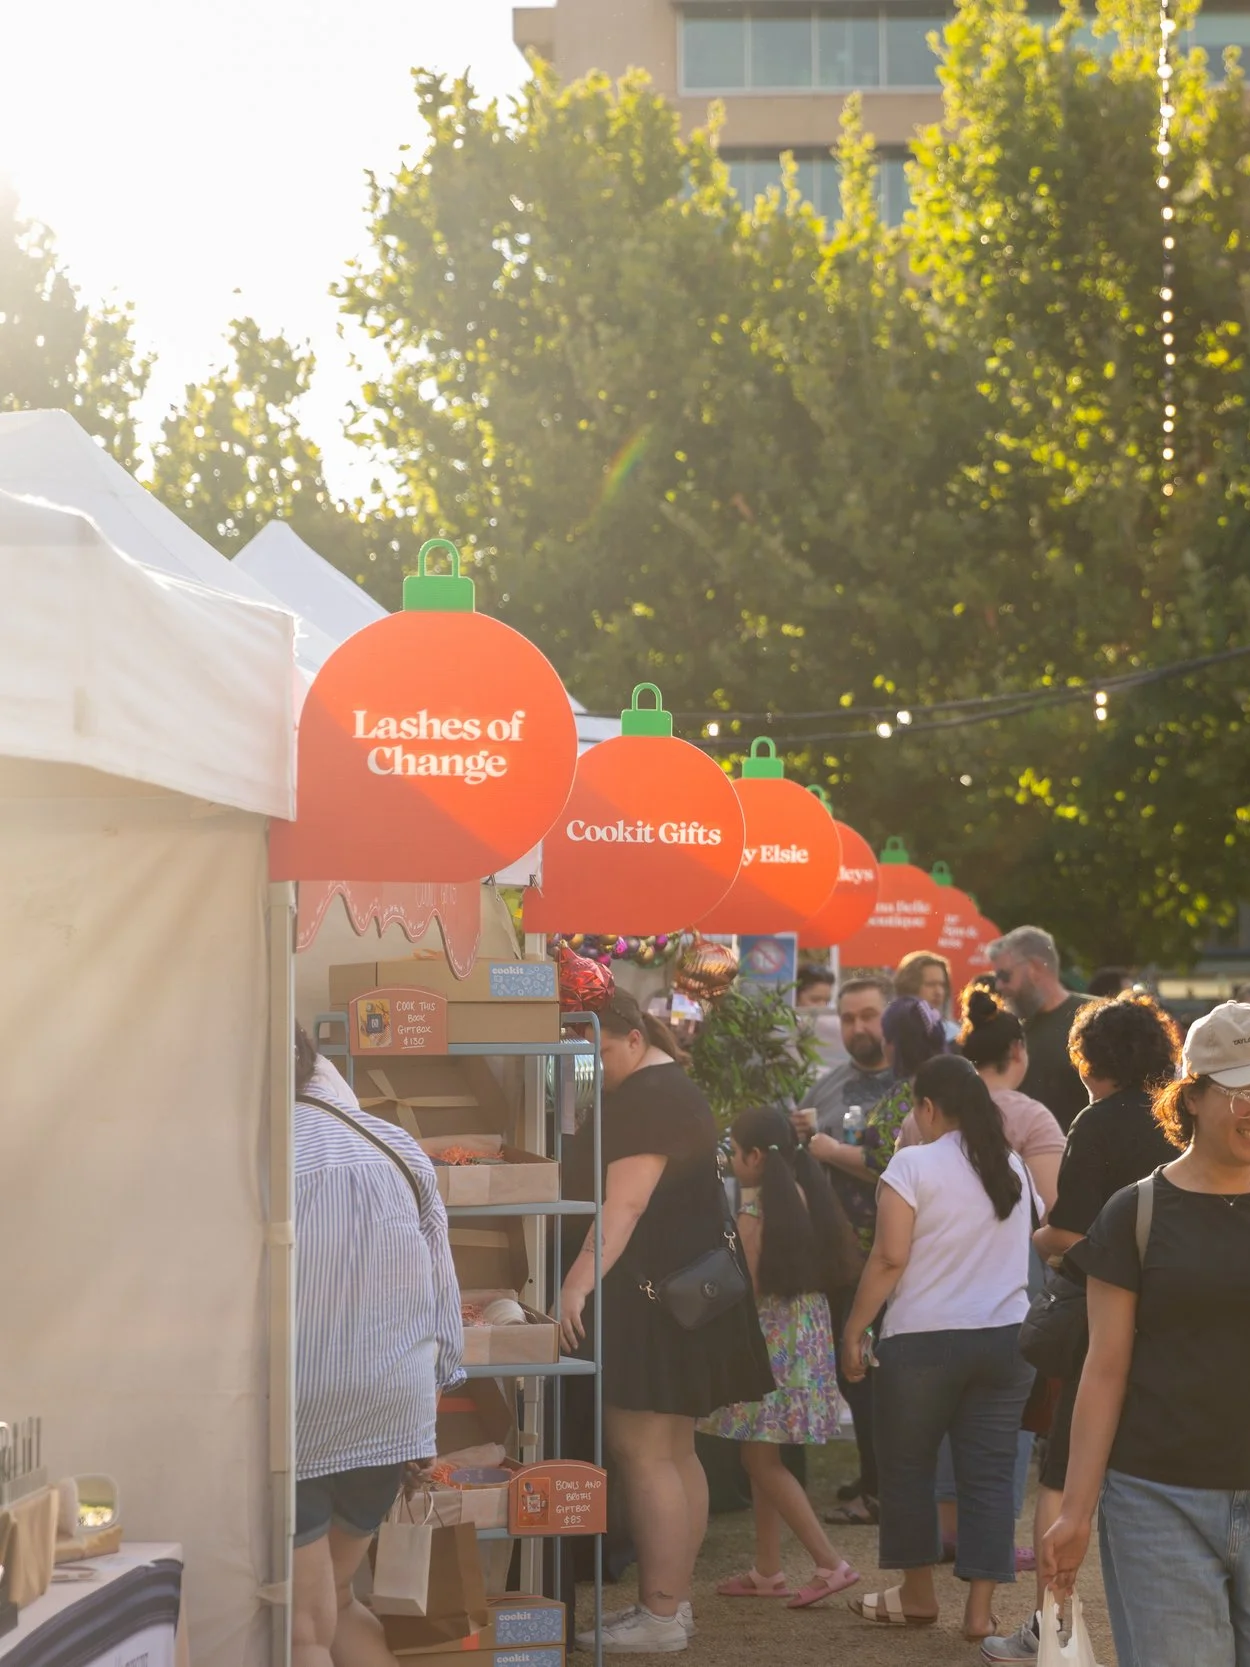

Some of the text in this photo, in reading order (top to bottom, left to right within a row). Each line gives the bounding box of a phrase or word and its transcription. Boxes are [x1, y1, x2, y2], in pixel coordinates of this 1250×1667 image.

[352, 708, 526, 742] Lashes of
[367, 744, 508, 785] Change
[566, 820, 721, 846] Cookit Gifts
[760, 844, 809, 864] Elsie
[491, 966, 525, 975] cookit
[396, 1001, 437, 1011] COOK THIS
[407, 1014, 426, 1023] BOOK
[403, 1036, 425, 1046] $130
[555, 1480, 602, 1490] BOWLS AND
[566, 1492, 592, 1502] BROTHS
[563, 1515, 582, 1525] $85
[498, 1612, 532, 1621] cookit
[496, 1653, 530, 1663] cookit
